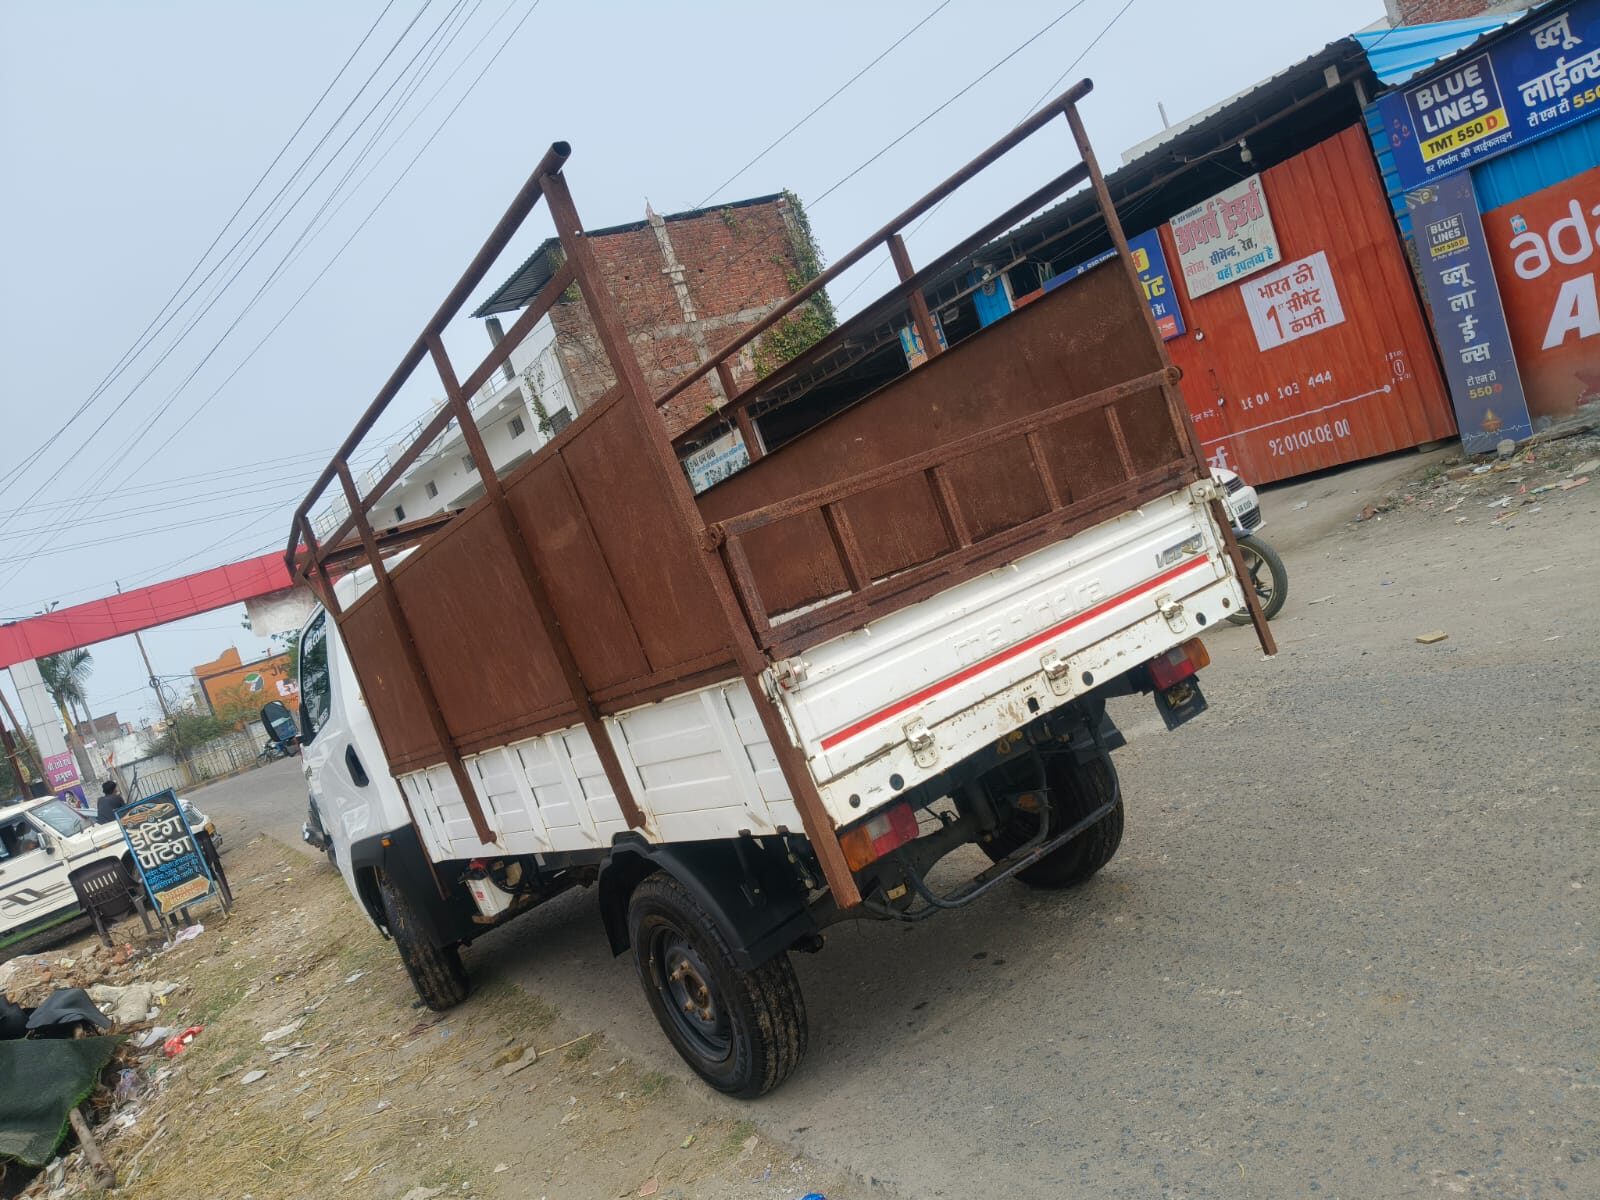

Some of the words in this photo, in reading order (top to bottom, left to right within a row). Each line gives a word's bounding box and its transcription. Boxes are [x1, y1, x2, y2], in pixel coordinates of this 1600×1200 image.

[1530, 11, 1583, 50] ब्लू
[1415, 64, 1482, 111] BLUE
[1422, 88, 1488, 133] LINES
[1428, 134, 1454, 154] TMT
[1457, 122, 1484, 142] 550
[1485, 115, 1498, 131] D
[1430, 217, 1459, 234] BLUE
[1432, 227, 1460, 244] LINES
[1509, 199, 1600, 280] ad
[1258, 276, 1291, 298] भारत
[1292, 263, 1314, 284] की
[1440, 262, 1475, 287] ब्लू
[1469, 385, 1493, 399] 550
